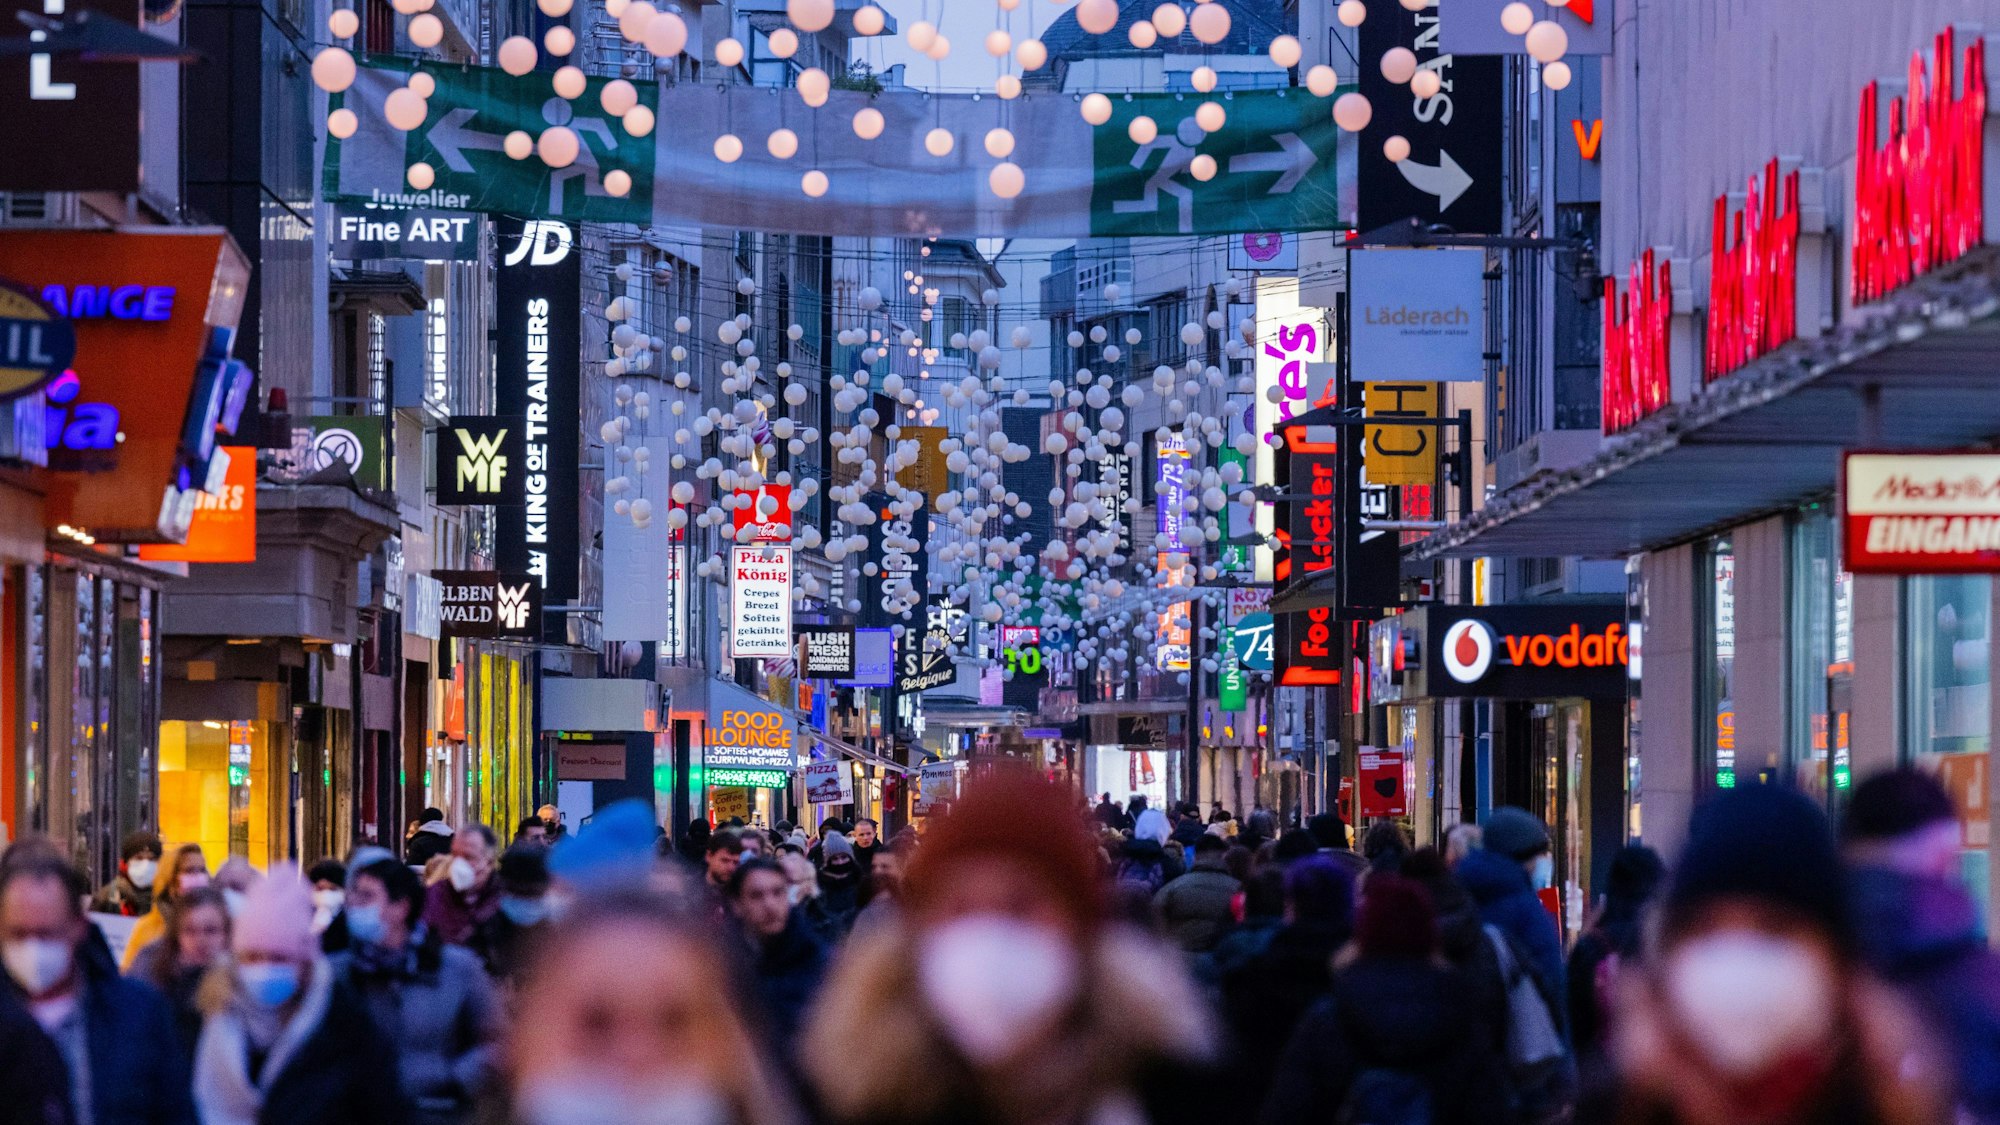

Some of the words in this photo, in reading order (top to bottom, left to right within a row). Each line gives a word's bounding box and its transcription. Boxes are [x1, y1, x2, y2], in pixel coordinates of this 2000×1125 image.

[365, 189, 470, 209] Juwelier
[341, 217, 400, 242] Fine
[407, 218, 470, 242] ART
[505, 221, 572, 266] JD
[41, 284, 177, 321] ANGE
[1365, 303, 1469, 325] Läderach
[0, 322, 54, 365] IL
[526, 298, 548, 441] TRAINERS
[45, 368, 120, 450] ia
[456, 429, 508, 492] WMF
[529, 443, 548, 469] OF
[194, 484, 245, 511] NES
[526, 470, 548, 543] KING
[1303, 463, 1333, 571] Locker
[741, 552, 784, 565] Pizza
[737, 567, 787, 583] König
[743, 588, 780, 599] Crepes
[440, 605, 493, 622] WALD
[744, 600, 779, 610] Brezel
[742, 613, 781, 622] Softeis
[737, 625, 785, 636] gekühlte
[806, 631, 850, 645] LUSH
[736, 638, 787, 648] Getränke
[808, 646, 850, 656] FRESH
[901, 669, 953, 690] Belgique
[722, 710, 783, 730] FOOD
[712, 728, 792, 748] LOUNGE
[590, 757, 622, 766] Discount
[806, 764, 838, 776] PIZZA
[714, 771, 746, 783] PAPAS
[747, 773, 781, 784] FRITAS
[921, 769, 953, 779] Pommes
[715, 793, 744, 805] Coffee
[717, 805, 726, 813] to
[730, 803, 742, 812] go
